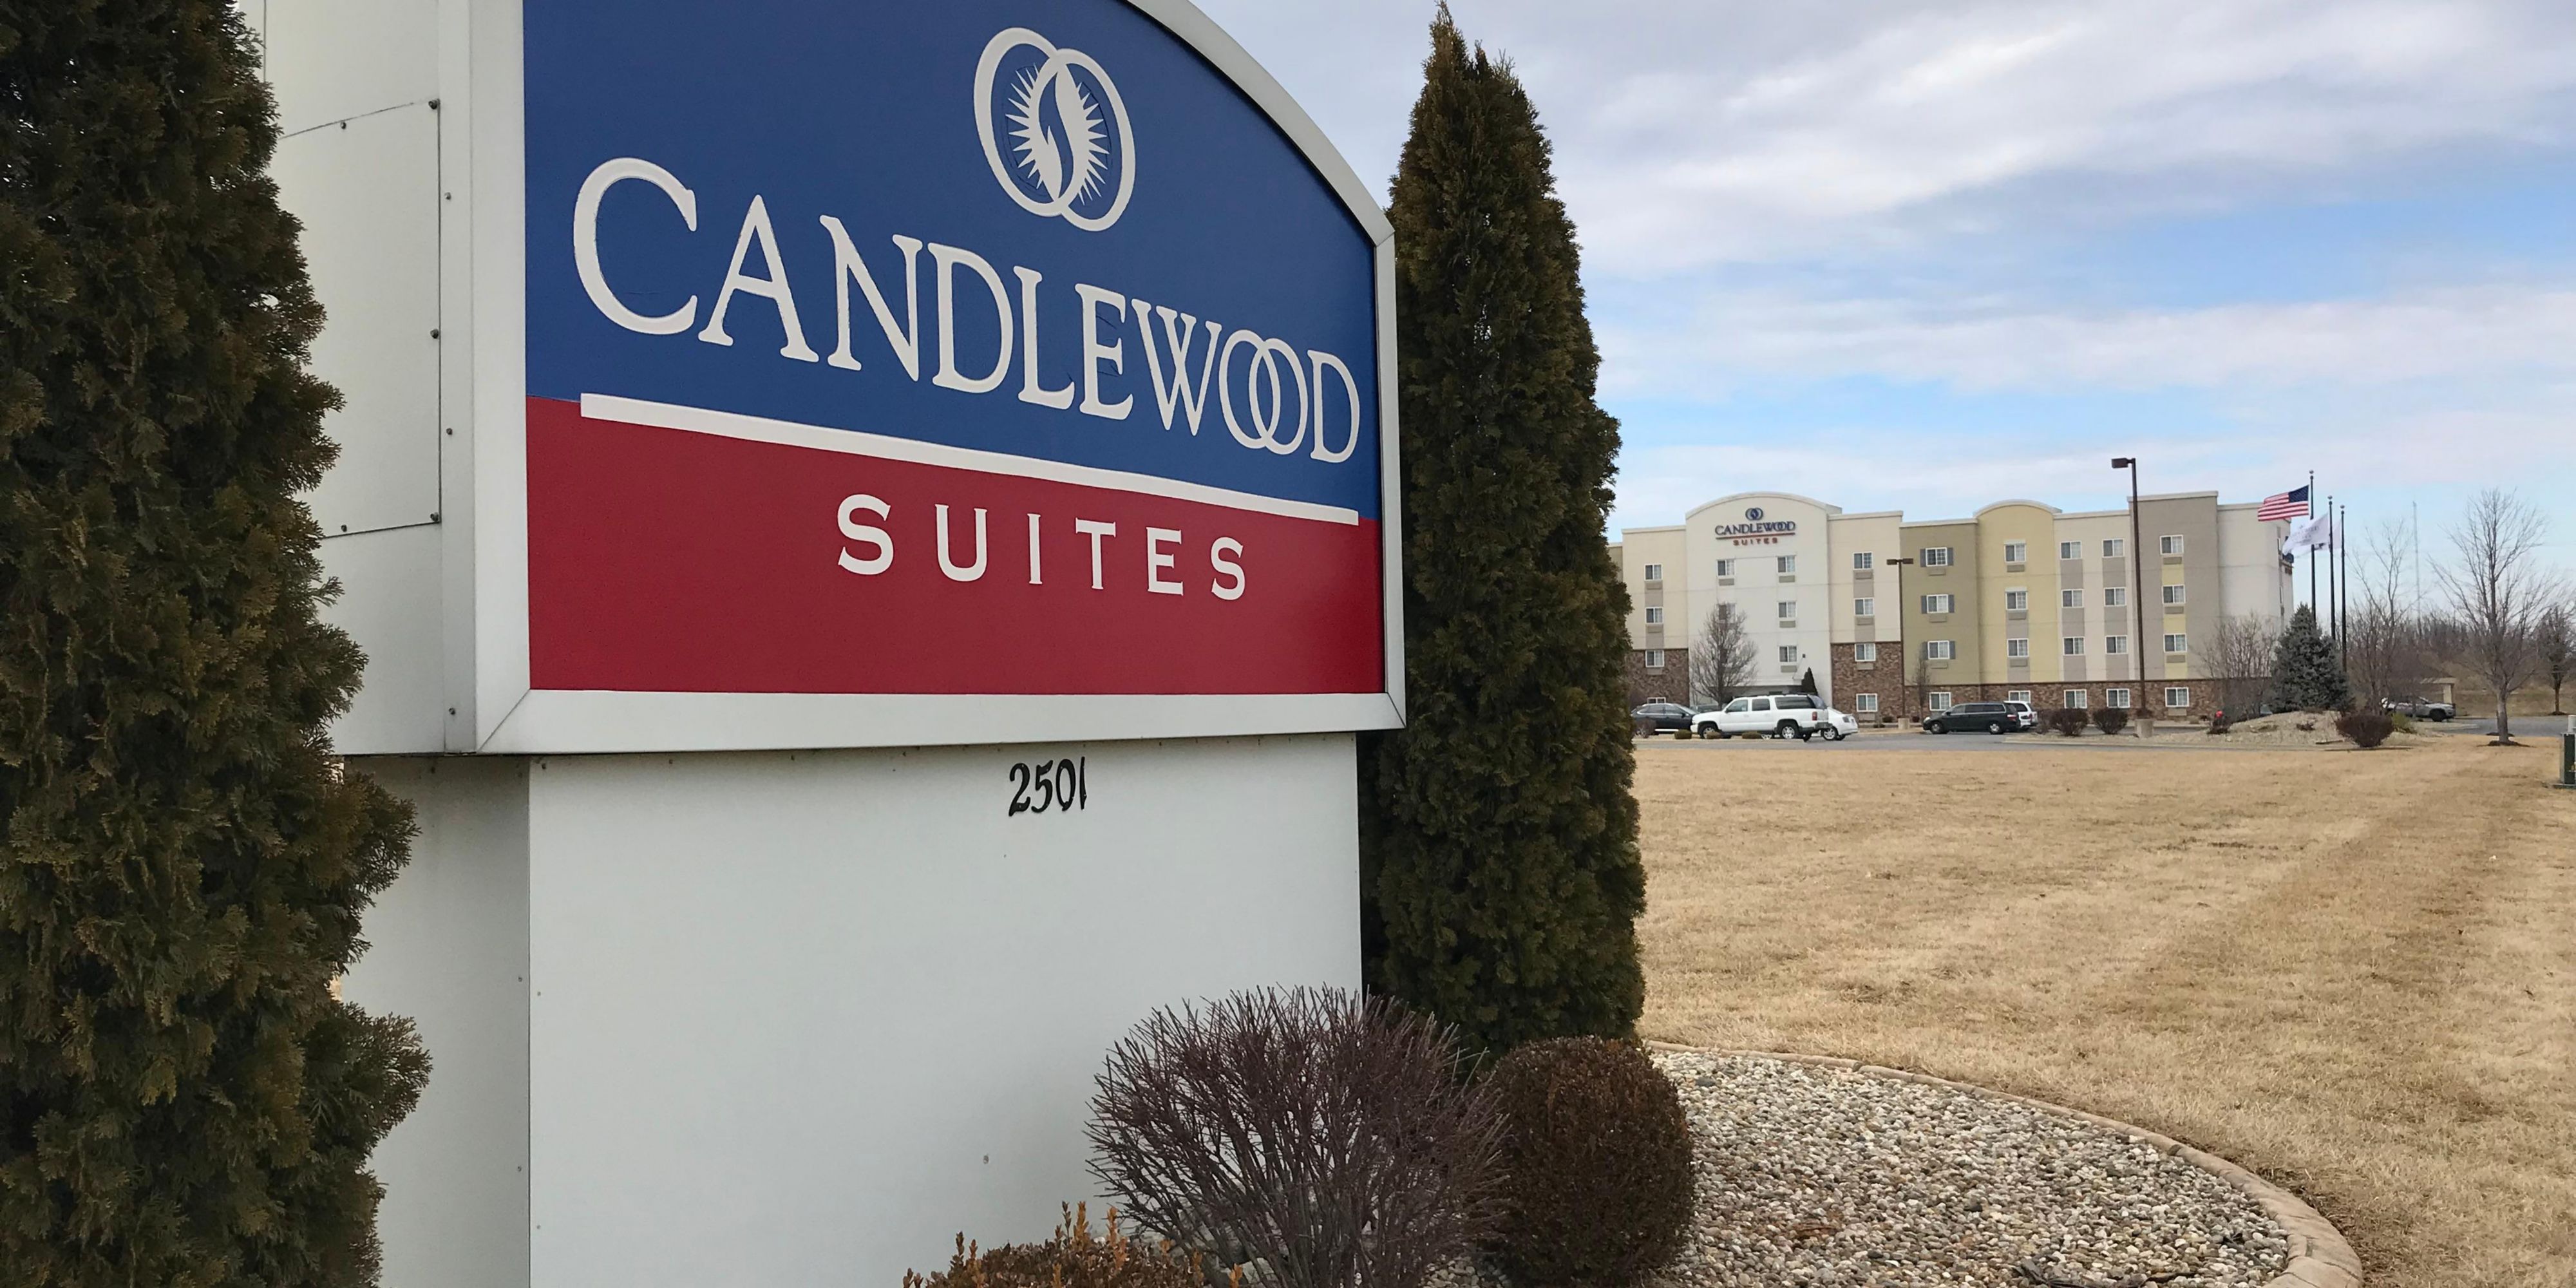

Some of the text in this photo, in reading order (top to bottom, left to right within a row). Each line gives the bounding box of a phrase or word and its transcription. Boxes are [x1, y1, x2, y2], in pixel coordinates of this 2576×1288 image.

[574, 158, 1359, 462] CANDLEWOOD
[838, 495, 1245, 600] SUITES
[1715, 521, 1795, 535] CANDLEWOOD
[1733, 537, 1777, 546] SUITES
[1008, 756, 1086, 817] 2501
